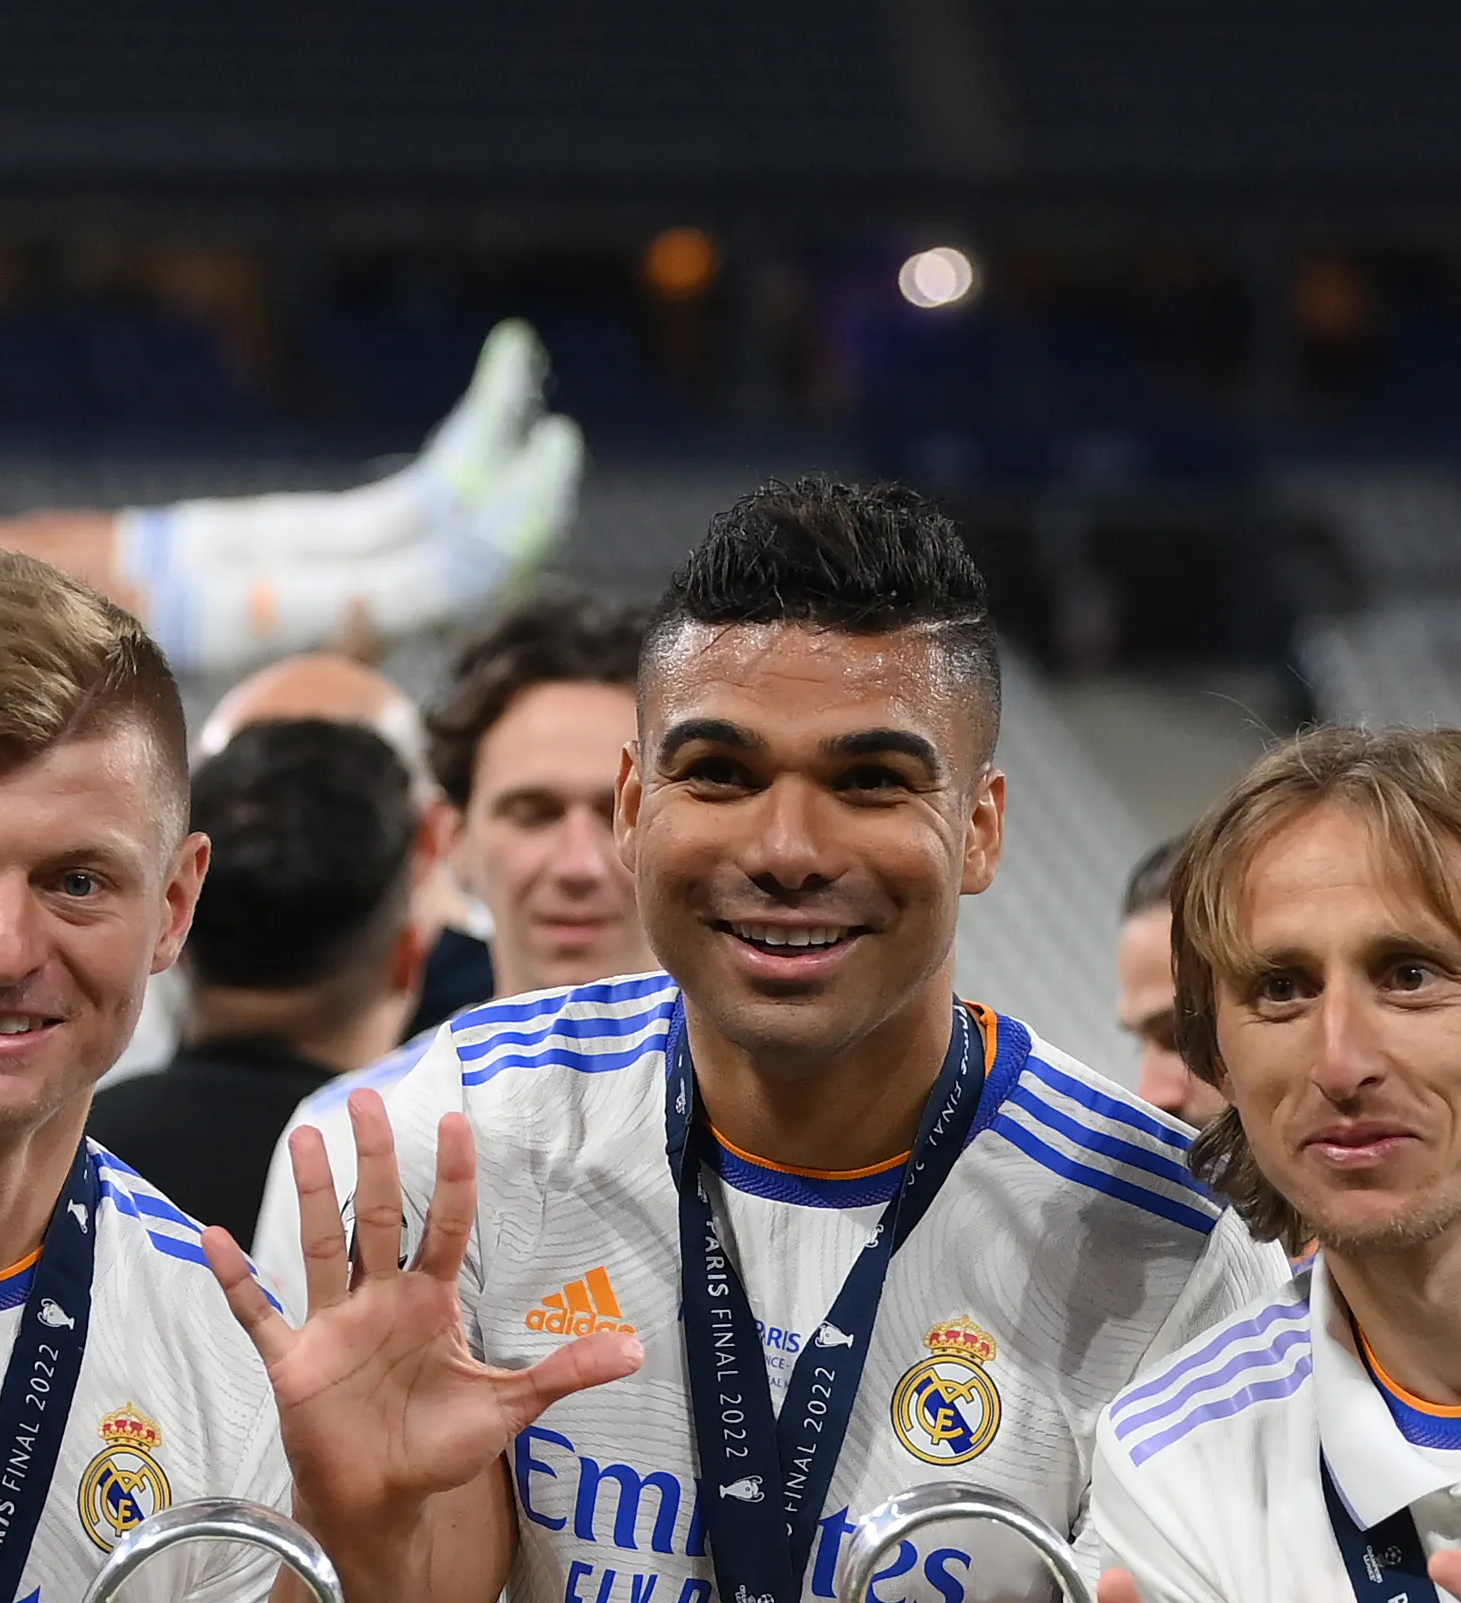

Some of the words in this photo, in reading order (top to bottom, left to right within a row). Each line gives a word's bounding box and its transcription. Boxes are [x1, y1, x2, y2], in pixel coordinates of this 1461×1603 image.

[710, 1309, 739, 1382] FINAL
[1, 1422, 40, 1492] FINAL
[25, 1344, 59, 1411] 2022
[719, 1393, 748, 1459] 2022
[804, 1367, 836, 1433] 2022
